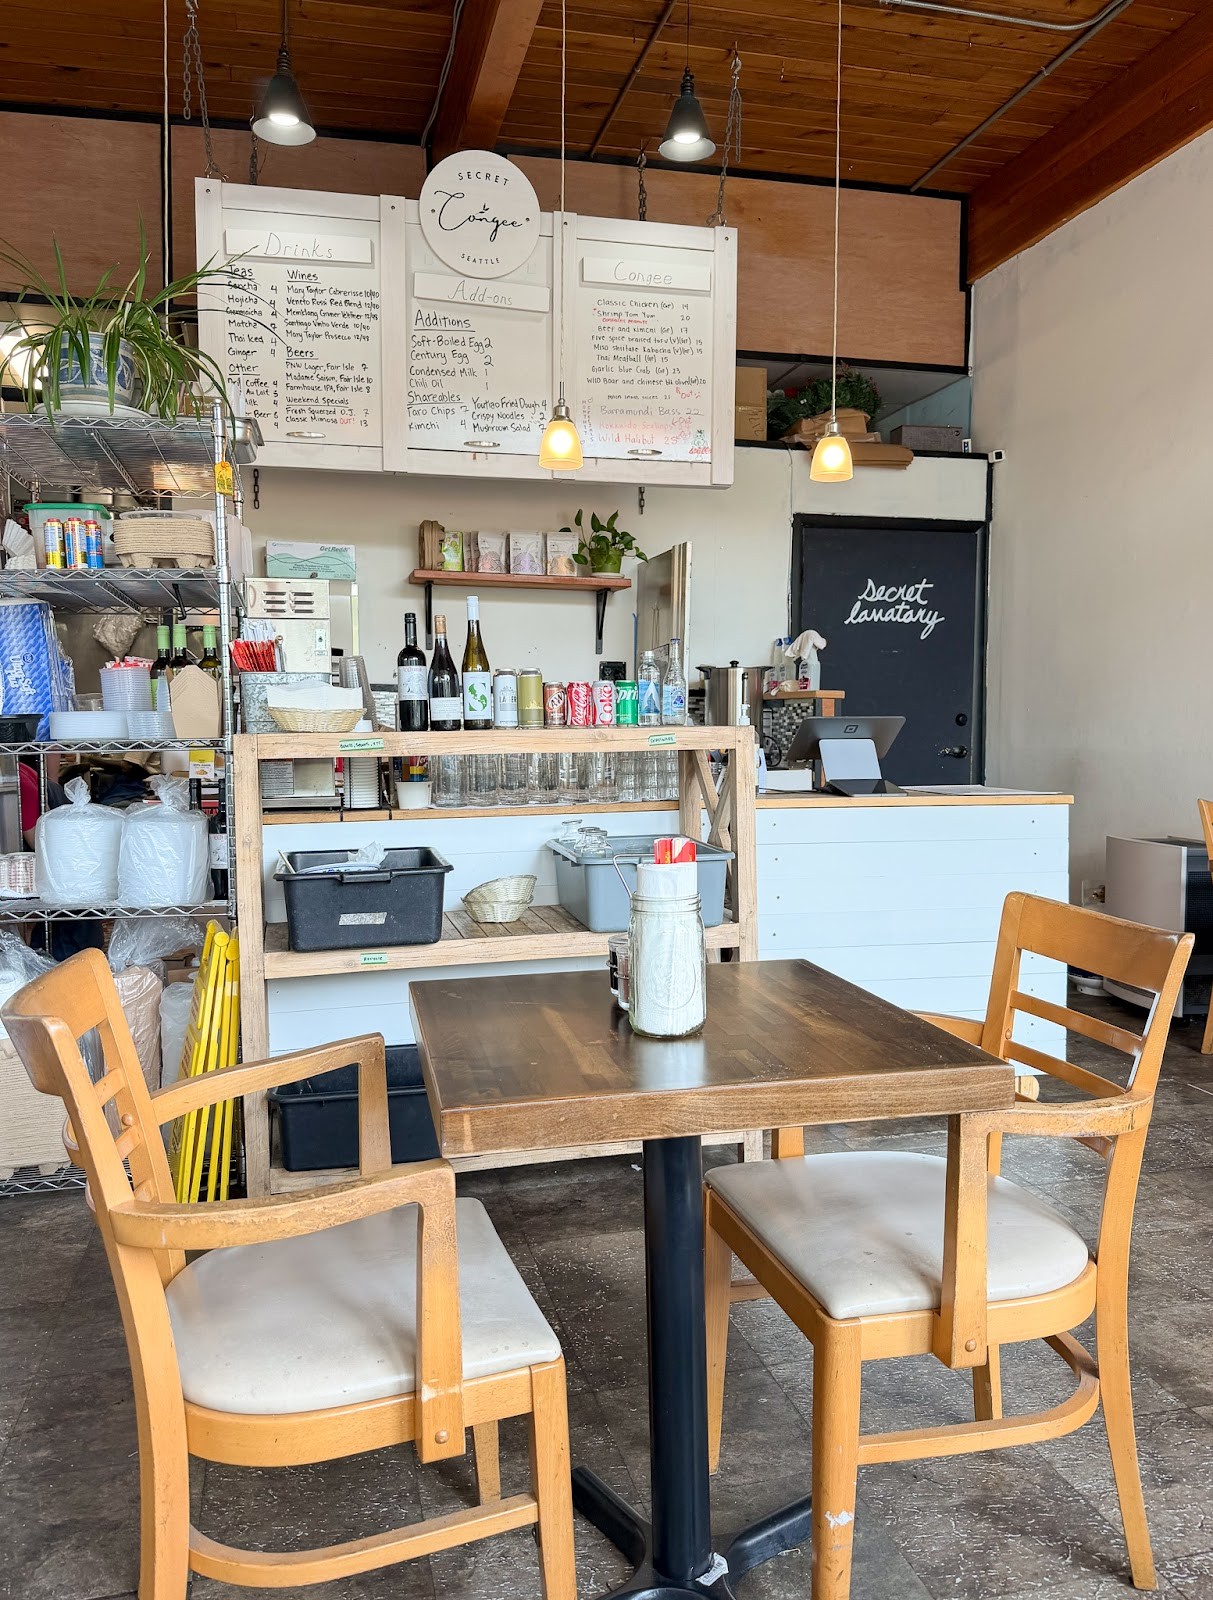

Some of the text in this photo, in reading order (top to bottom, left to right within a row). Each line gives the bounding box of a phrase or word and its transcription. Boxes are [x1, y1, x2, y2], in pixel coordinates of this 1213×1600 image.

[457, 171, 510, 186] SECRET
[434, 190, 523, 243] Congee
[264, 232, 333, 259] Drinks
[461, 253, 500, 265] SEATTLE
[227, 264, 254, 277] Teas
[287, 269, 319, 281] Wines
[614, 261, 673, 286] Congee
[270, 285, 278, 294] 4
[286, 285, 304, 298] Mary
[305, 286, 327, 297] Taylor
[447, 279, 513, 306] Add-ons
[227, 295, 276, 309] Hojicha 4
[286, 297, 310, 306] Veneto
[329, 298, 342, 307] Red
[597, 299, 626, 307] Classic
[629, 300, 659, 309] Chicken
[414, 309, 472, 328] Additions
[597, 310, 623, 319] Shrimp
[228, 320, 258, 328] Matcha
[330, 321, 349, 329] Verde
[228, 332, 246, 343] Thai
[270, 338, 277, 346] 4
[285, 329, 303, 343] Mary
[304, 330, 323, 341] Taylor
[410, 335, 494, 354] Soft-Boiled Egg 2
[227, 347, 276, 361] Ginger 4
[286, 346, 315, 358] Beers
[410, 350, 494, 367] Century Egg 2
[228, 364, 259, 373] Other
[361, 363, 369, 371] 7
[409, 365, 478, 377] Condensed Milk
[591, 365, 614, 373] Garlic
[245, 379, 278, 388] Coffee 4
[285, 373, 314, 381] Madame
[340, 374, 352, 382] Fair
[353, 375, 366, 383] Isle
[366, 376, 373, 384] 10
[409, 378, 444, 389] Chili Oil
[273, 389, 278, 397] 5
[285, 383, 322, 391] Farmhouse
[351, 385, 364, 393] Isle
[273, 399, 278, 407] 4
[285, 396, 350, 406] Weekend Specials
[407, 391, 461, 404] Shareables
[285, 407, 306, 415] Fresh
[500, 396, 519, 409] Fried
[519, 397, 541, 415] Dough
[541, 399, 547, 411] 4
[600, 405, 704, 417] Barramundi Bass 22
[253, 409, 272, 418] Beer
[407, 405, 470, 419] Taro Chips 7
[310, 416, 338, 424] Mimosa
[471, 412, 547, 425] Crispy Noodles 2
[273, 421, 279, 429] 4
[408, 420, 467, 432] Kimchi 4
[472, 422, 509, 433] Mushroom
[510, 423, 531, 432] Salad
[598, 433, 621, 443] Wild
[624, 434, 655, 445] Halibut
[599, 685, 613, 725] Coke
